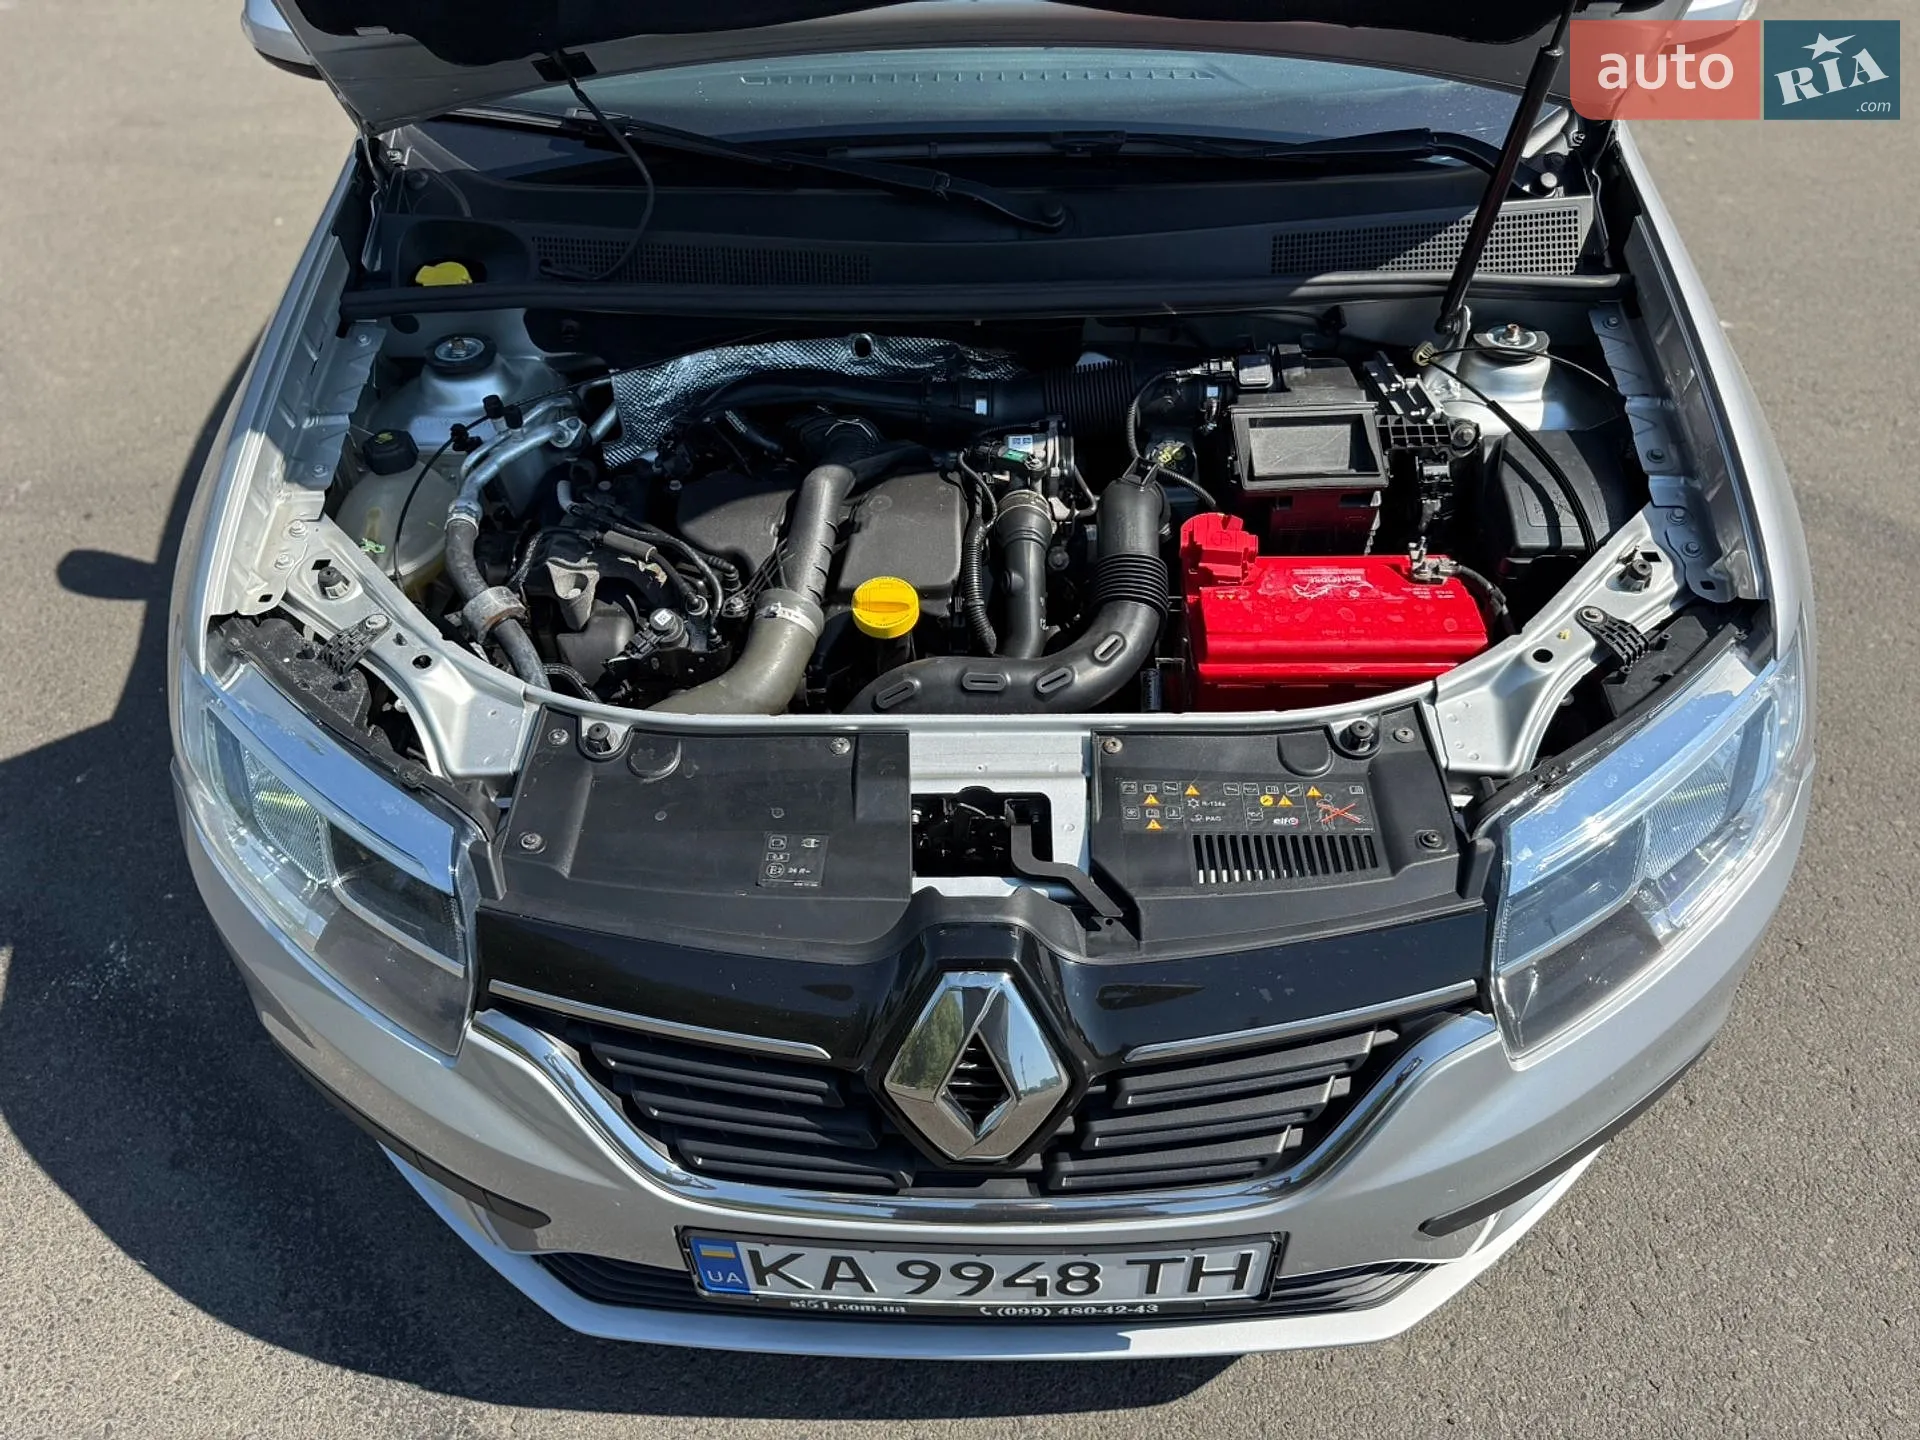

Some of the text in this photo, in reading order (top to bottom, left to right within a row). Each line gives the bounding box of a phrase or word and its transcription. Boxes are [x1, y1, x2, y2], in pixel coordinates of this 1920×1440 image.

[706, 1269, 743, 1286] UA
[747, 1249, 1253, 1298] KA 9948 TH
[1058, 1303, 1160, 1316] 480-42-43
